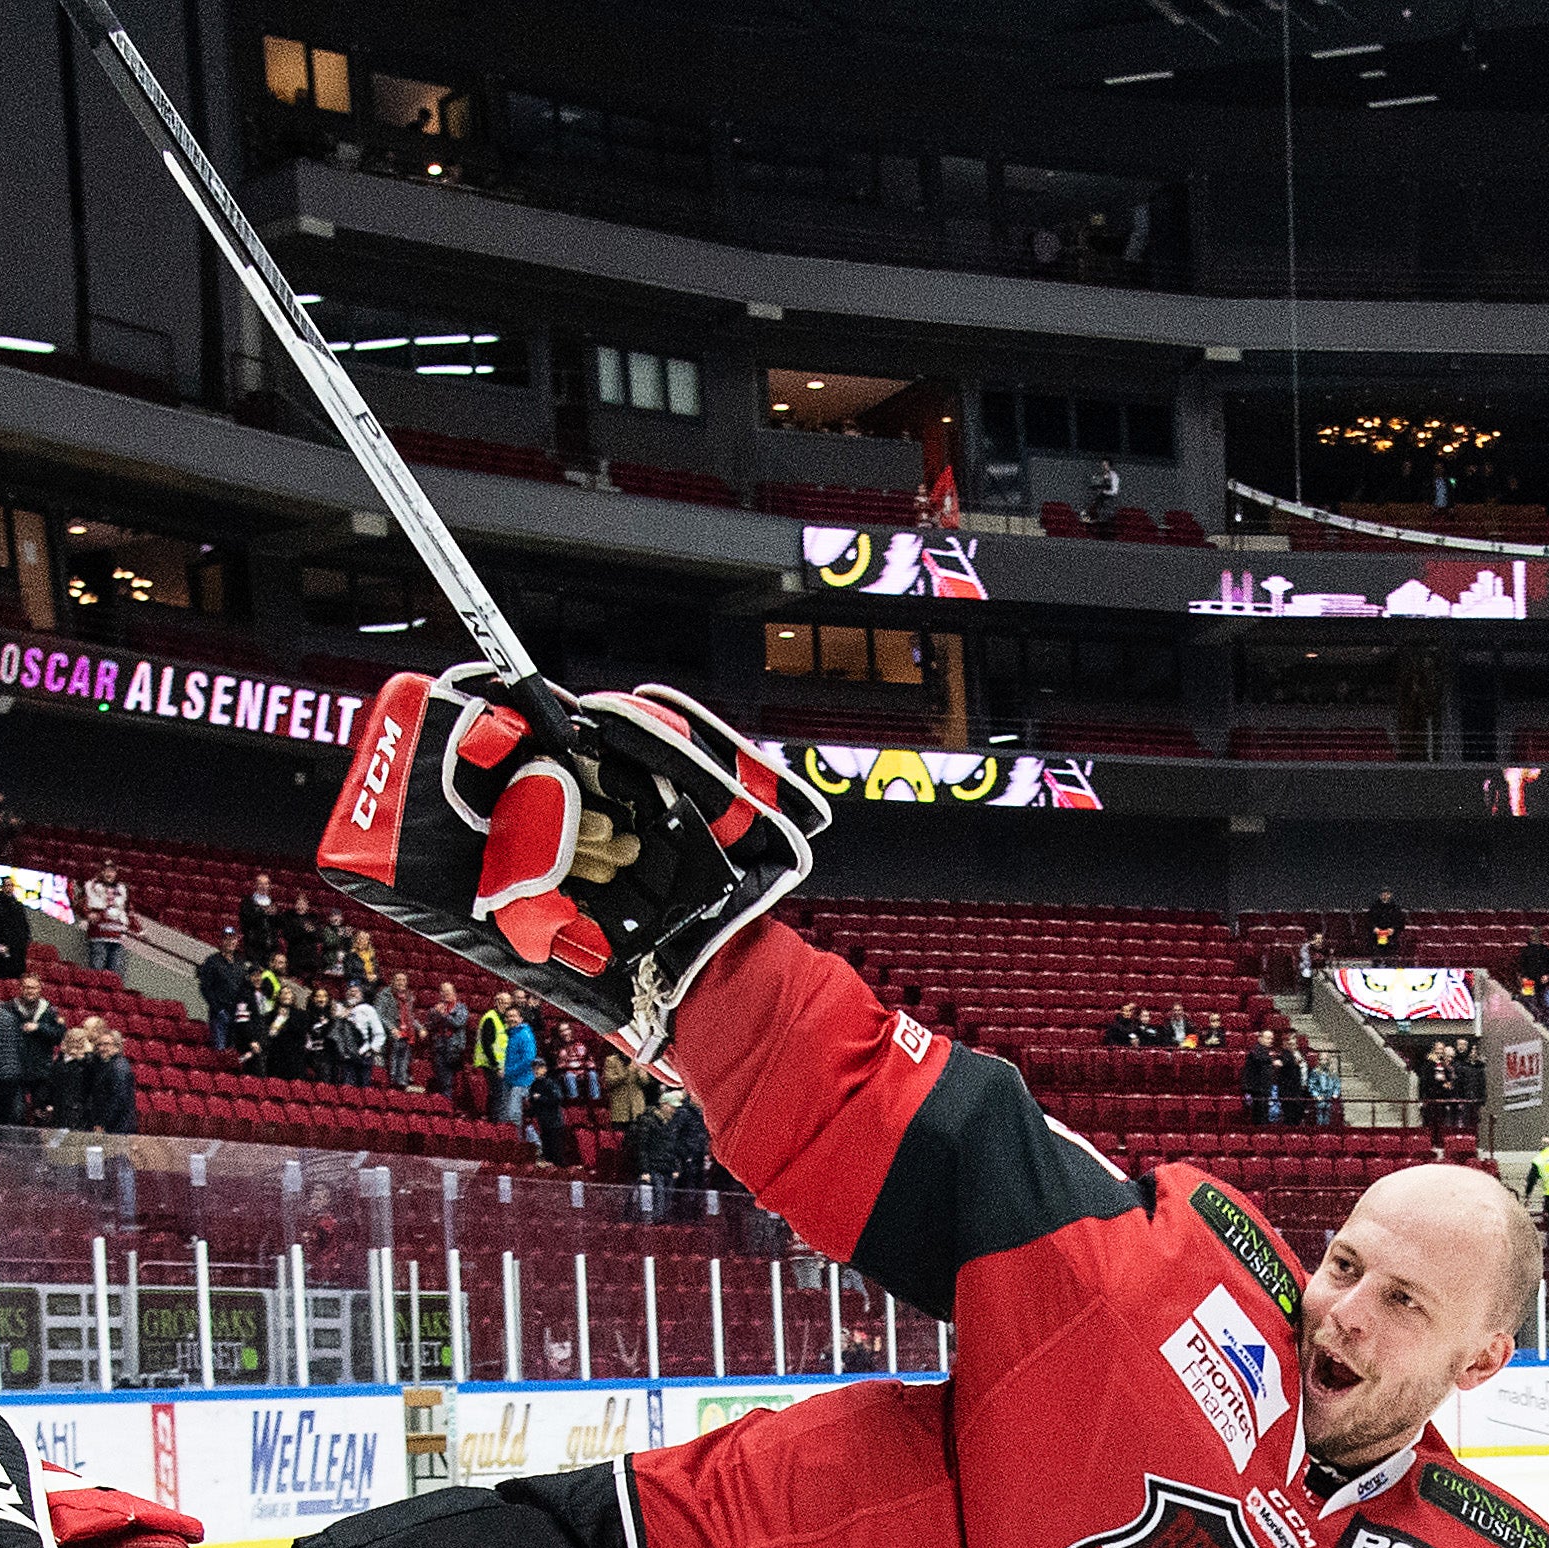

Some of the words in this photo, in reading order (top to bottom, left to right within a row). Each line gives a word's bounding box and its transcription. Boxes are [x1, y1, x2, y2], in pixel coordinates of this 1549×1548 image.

[0, 643, 118, 701] OSCAR
[124, 661, 363, 746] ALSENFELT
[351, 716, 403, 831] CCM
[1224, 1225, 1281, 1294] HUSET
[1182, 1361, 1238, 1443] Finans
[1187, 1334, 1252, 1444] Prioritet
